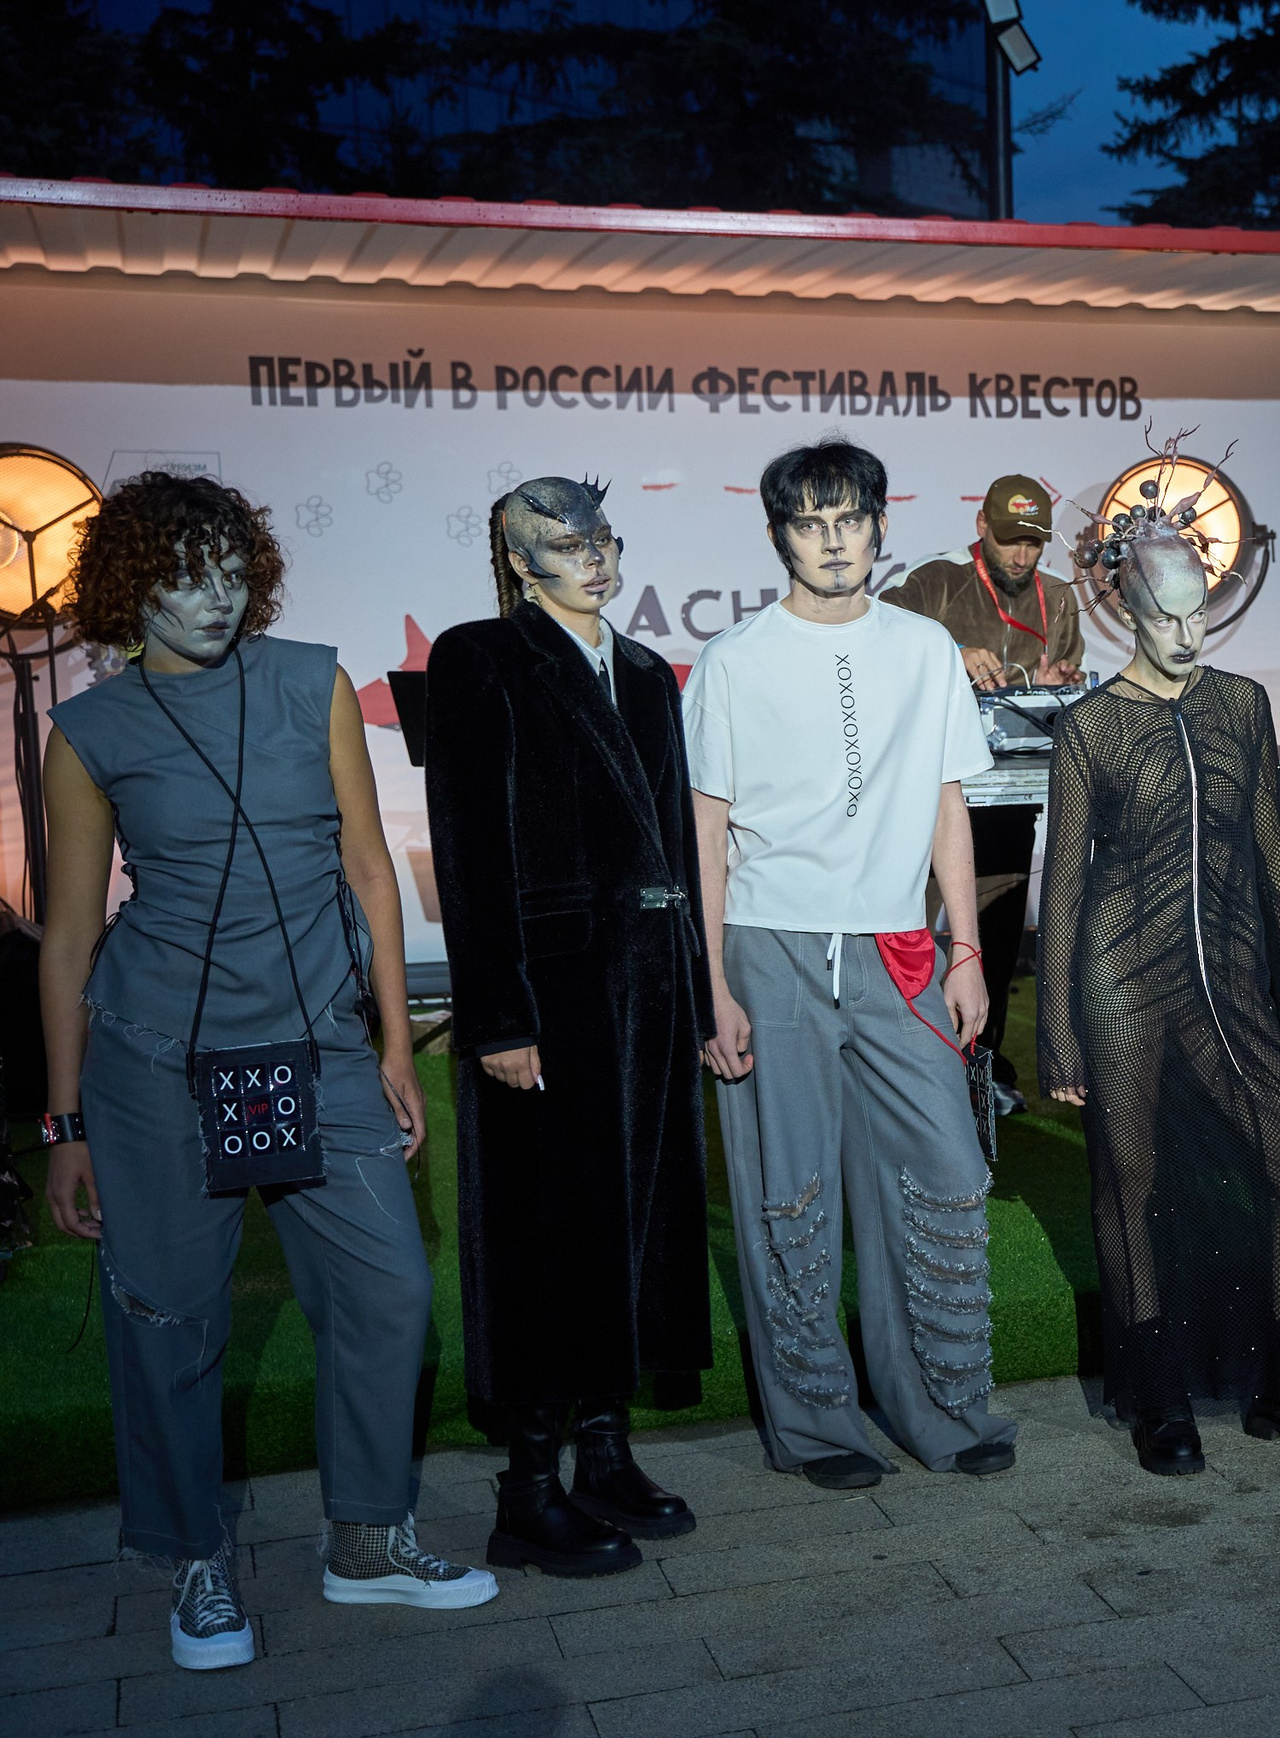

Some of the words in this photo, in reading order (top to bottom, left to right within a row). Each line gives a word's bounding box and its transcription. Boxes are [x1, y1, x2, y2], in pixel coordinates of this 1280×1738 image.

[249, 348, 433, 409] ПЕРВЫЙ
[450, 361, 478, 410] В
[495, 365, 675, 413] РОССИИ
[691, 366, 952, 417] ФЕСТИВАЛЬ
[968, 373, 1142, 421] КВЕСТОВ
[248, 1103, 269, 1114] VIP
